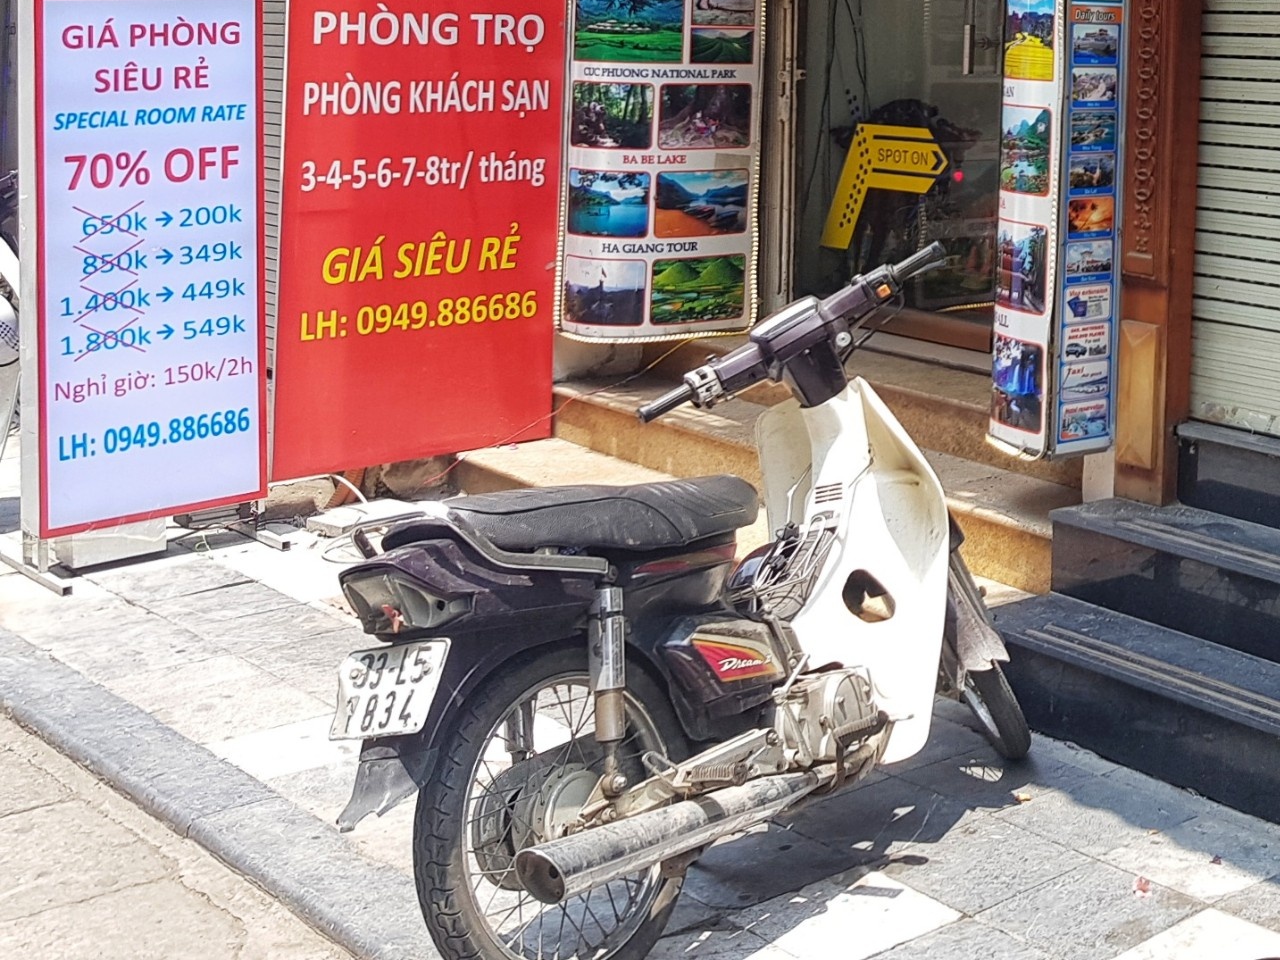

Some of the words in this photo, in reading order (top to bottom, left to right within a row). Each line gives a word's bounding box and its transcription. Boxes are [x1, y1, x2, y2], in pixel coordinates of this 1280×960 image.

[313, 3, 459, 46] PHÒNG
[470, 13, 545, 52] TRỌ
[1075, 8, 1095, 22] Daily
[61, 18, 119, 49] GIÁ
[129, 16, 241, 47] PHÒNG
[94, 61, 162, 93] SIÊU
[174, 56, 209, 90] RẺ
[583, 67, 600, 77] CUC
[601, 67, 649, 78] PHUONG
[651, 68, 710, 79] NATIONAL
[711, 69, 737, 79] PARK
[302, 73, 401, 115] PHÒNG
[409, 72, 495, 113] KHÁCH
[501, 79, 549, 118] SẠN
[53, 110, 129, 131] SPECIAL
[135, 107, 196, 126] ROOM
[201, 104, 247, 121] RATE
[64, 150, 150, 191] 70%
[164, 145, 240, 183] OFF
[623, 155, 638, 165] BA
[641, 155, 654, 165] BE
[656, 154, 687, 165] LAKE
[877, 147, 908, 165] SPOT
[911, 150, 928, 166] ON
[301, 150, 474, 191] 3-4-5-6-7-8tr/
[478, 151, 546, 187] tháng
[179, 203, 242, 228] 200k
[179, 241, 242, 265] 349k
[322, 236, 386, 284] GIÁ
[393, 231, 471, 278] SIÊU
[478, 222, 522, 271] RẺ
[601, 243, 620, 254] HA
[622, 243, 665, 254] GIANG
[666, 242, 698, 252] TOUR
[182, 277, 246, 302] 449k
[183, 315, 246, 340] 549k
[300, 309, 347, 341] LH:
[356, 290, 537, 336] 0949.886686
[54, 374, 107, 403] Nghỉ
[114, 372, 156, 397] giờ:
[164, 356, 253, 386] 150k/2h
[1068, 367, 1084, 375] Taxi
[59, 433, 96, 461] LH:
[103, 407, 250, 454] 0949.886686
[718, 657, 763, 672] Dream
